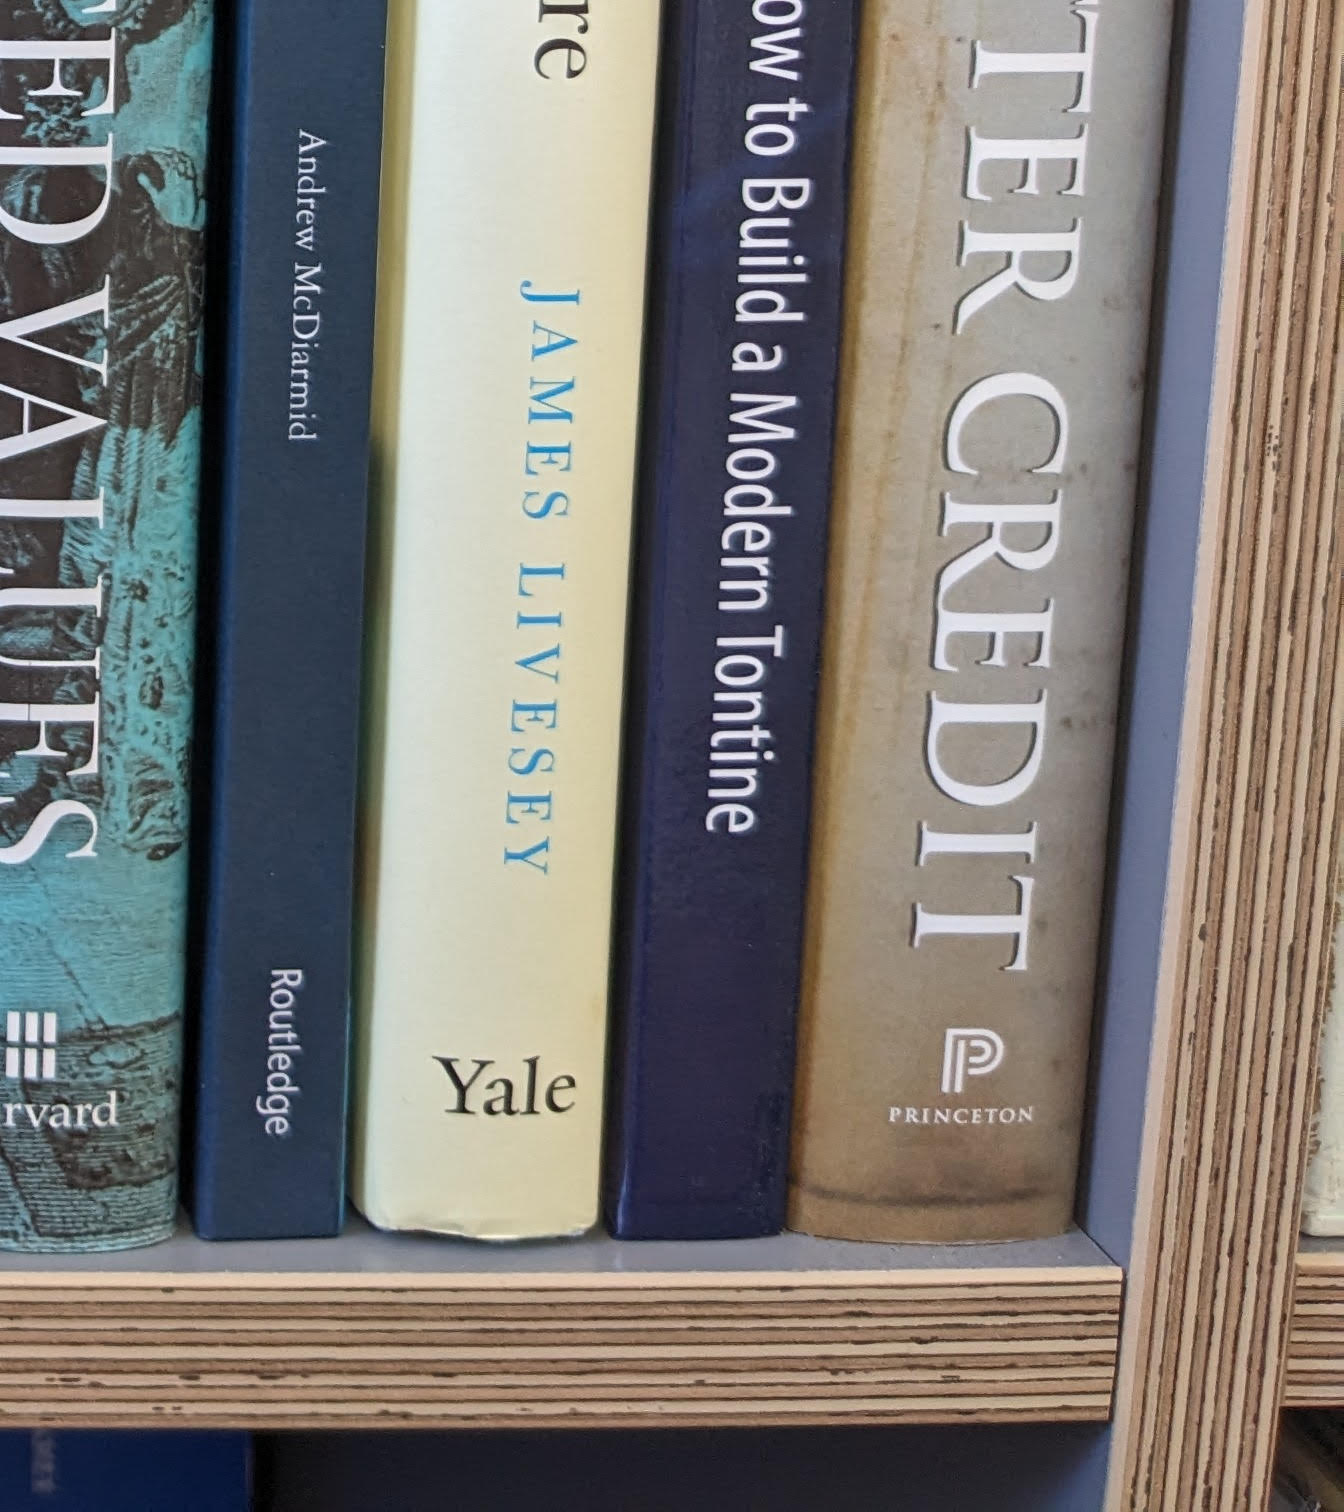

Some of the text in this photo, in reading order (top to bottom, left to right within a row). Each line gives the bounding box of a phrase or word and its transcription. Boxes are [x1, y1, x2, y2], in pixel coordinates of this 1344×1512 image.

[742, 98, 810, 158] to
[287, 128, 329, 441] Andrew McDiarmid
[734, 176, 812, 324] Build
[730, 343, 783, 372] a
[503, 278, 582, 875] JAMES LIVESEY
[717, 391, 799, 612] Modern
[705, 624, 785, 834] Tontine
[910, 370, 1072, 972] CREDIT
[256, 968, 303, 1138] Routledge
[431, 1055, 578, 1116] Yale
[888, 1105, 1034, 1125] PRINCETON
